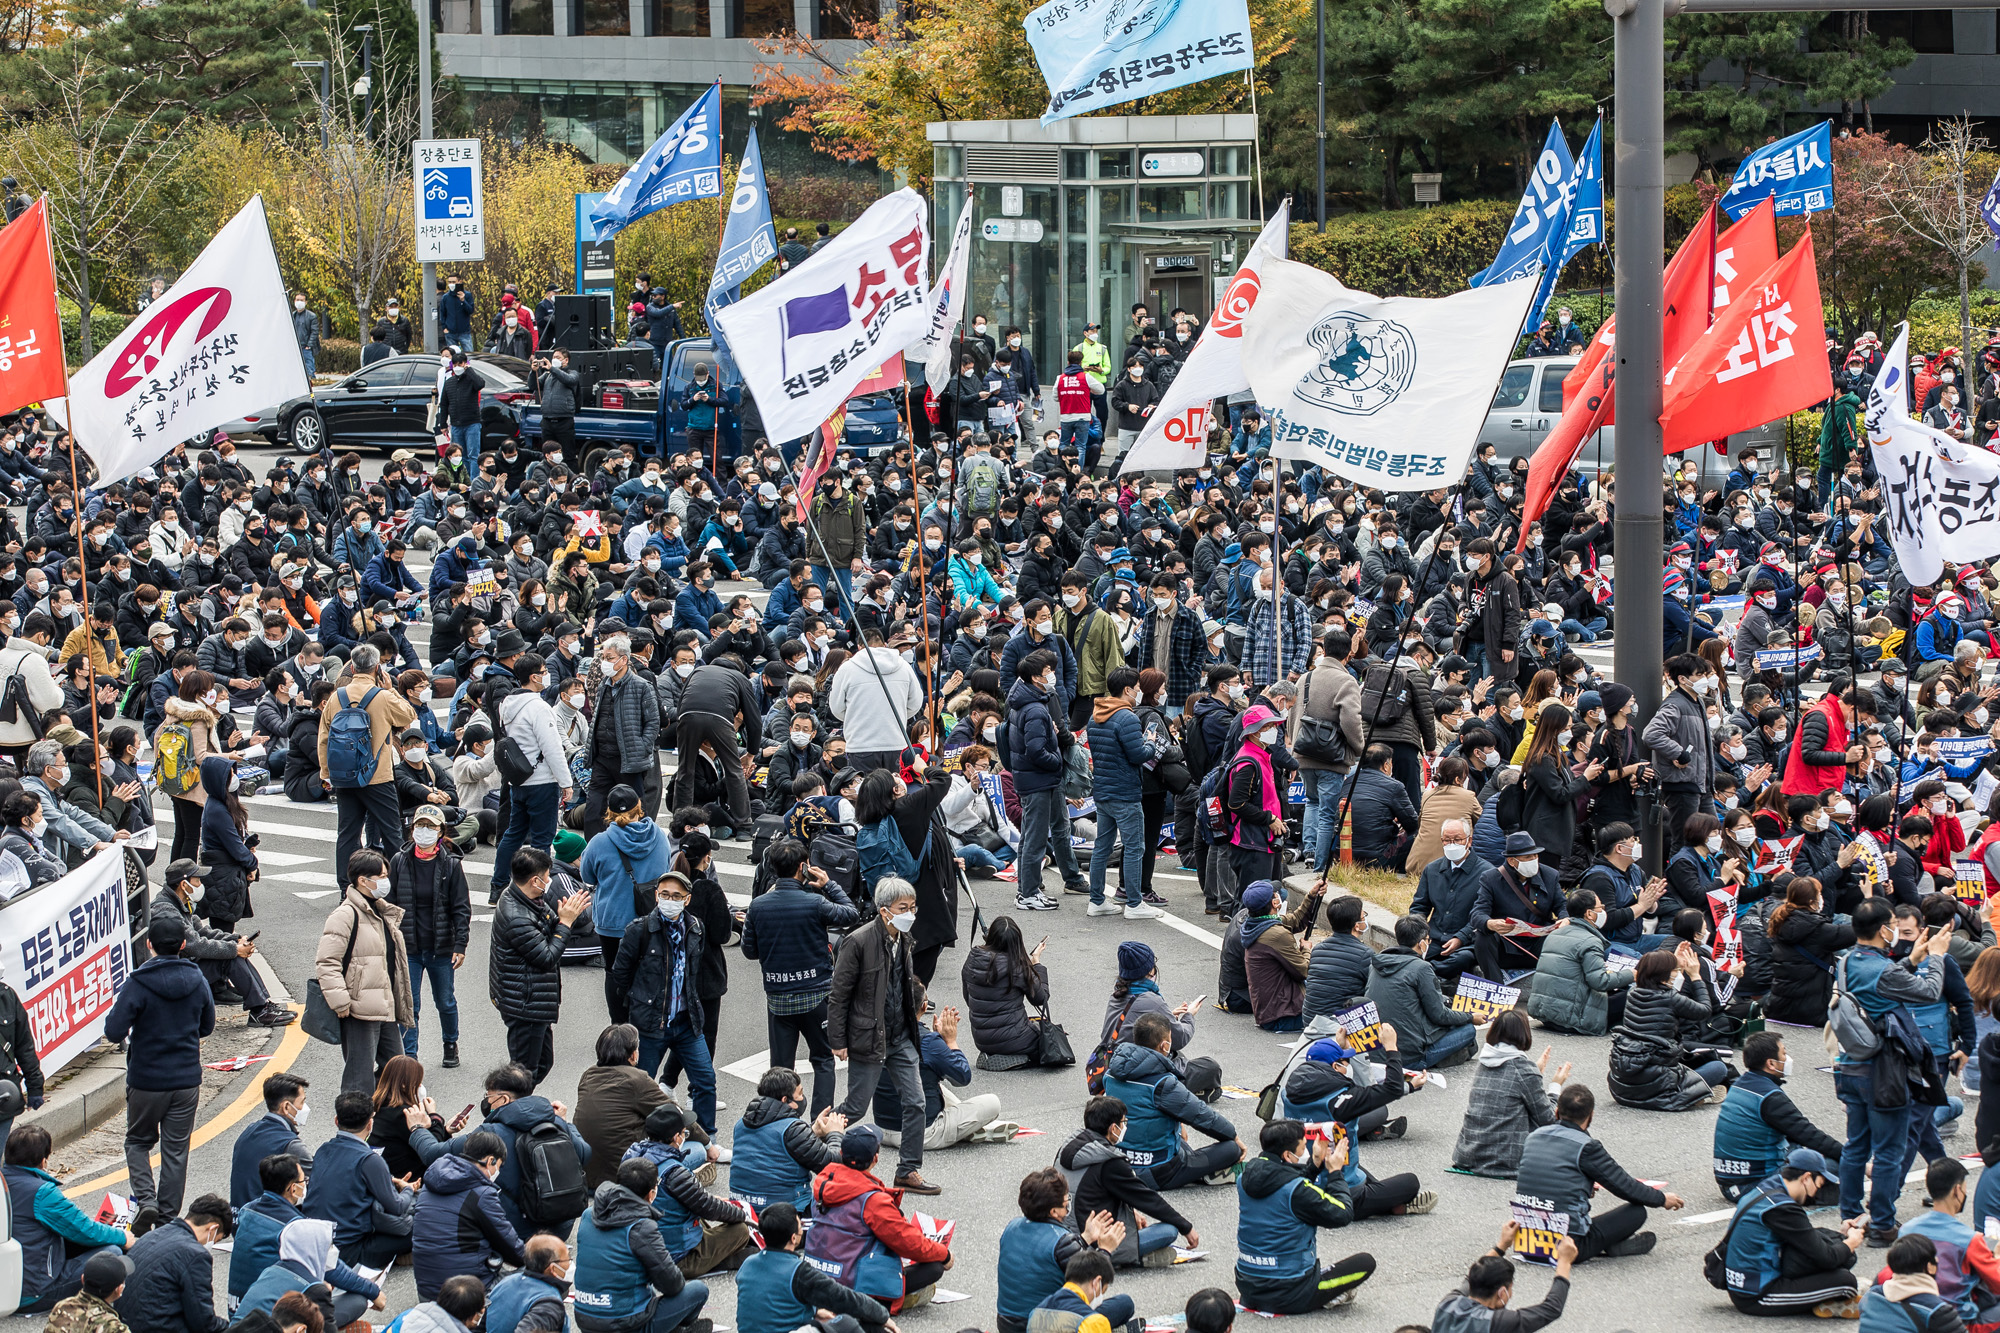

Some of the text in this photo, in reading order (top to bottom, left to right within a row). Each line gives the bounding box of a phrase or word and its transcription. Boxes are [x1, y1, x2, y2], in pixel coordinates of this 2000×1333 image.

[420, 147, 474, 163] 장충단로
[420, 225, 479, 238] 자전거우선도로
[21, 877, 125, 991] 모든 노동자에게
